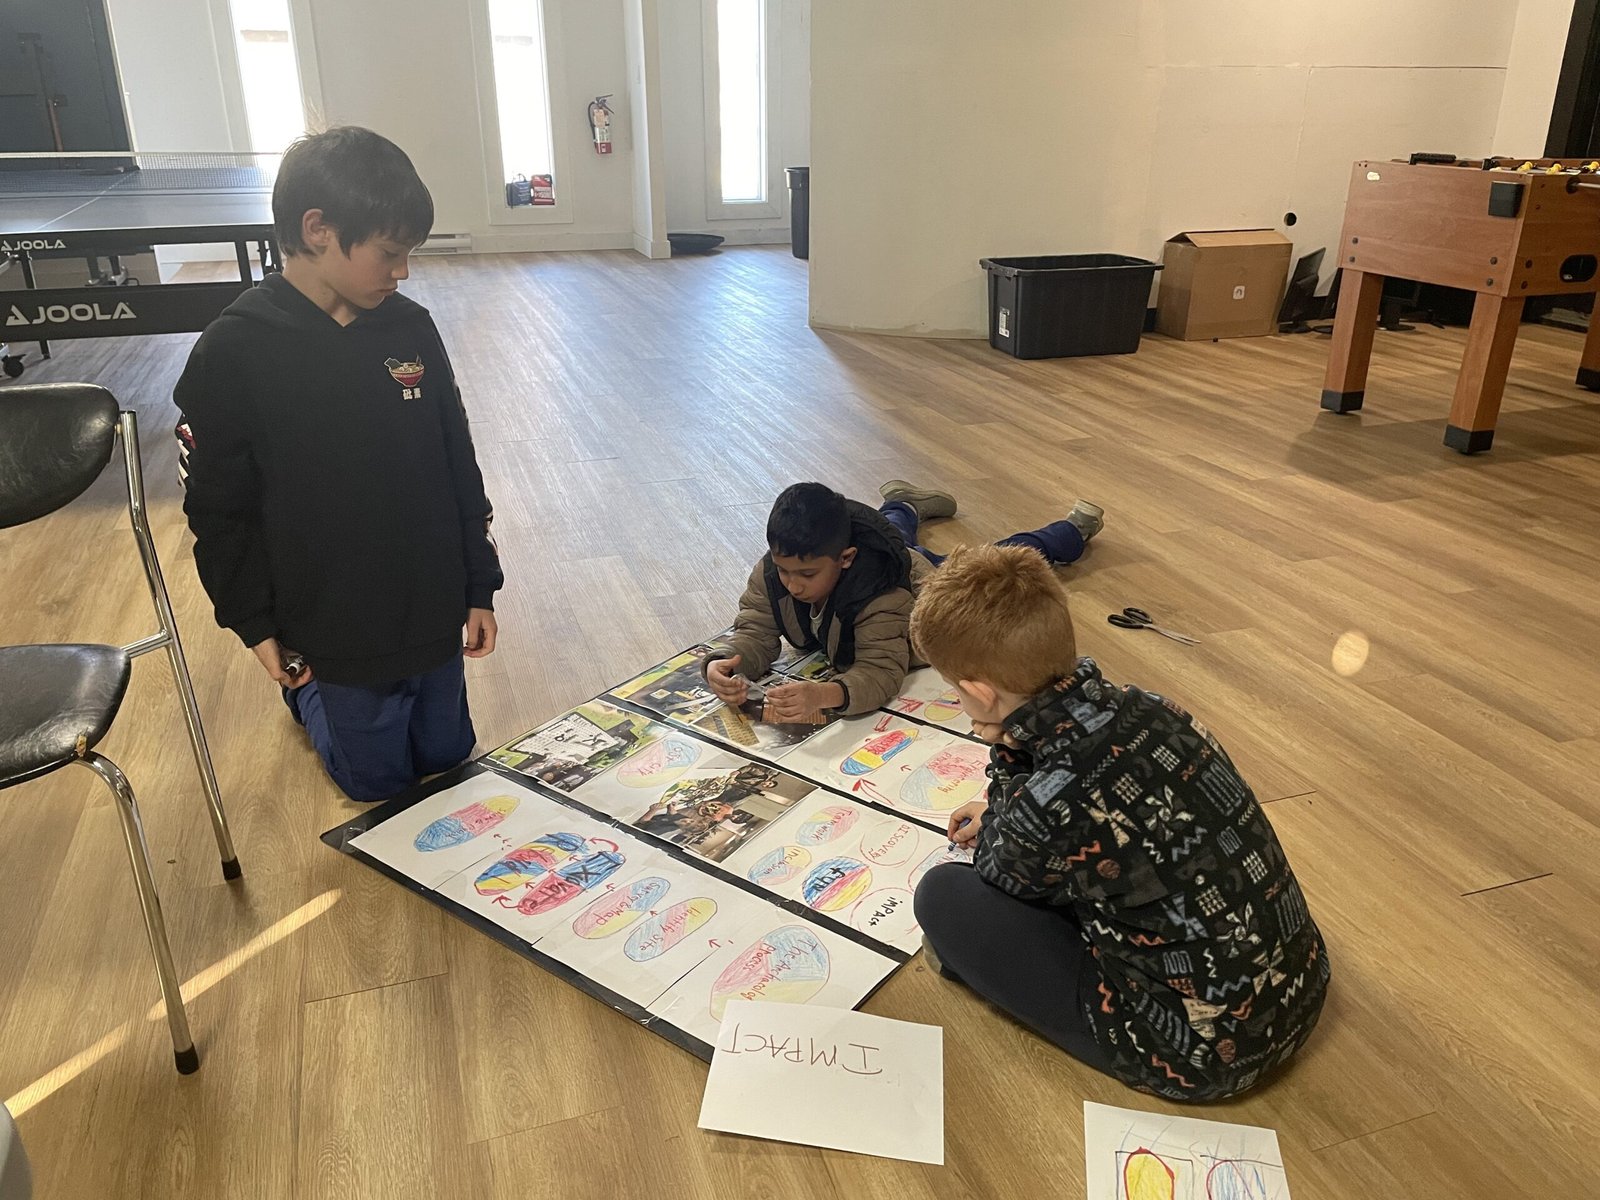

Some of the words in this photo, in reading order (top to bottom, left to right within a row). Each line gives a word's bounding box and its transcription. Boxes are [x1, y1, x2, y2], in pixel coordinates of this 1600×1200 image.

[14, 239, 67, 251] JOOLA
[32, 301, 137, 325] JOOLA
[721, 1022, 883, 1075] IMPACT
